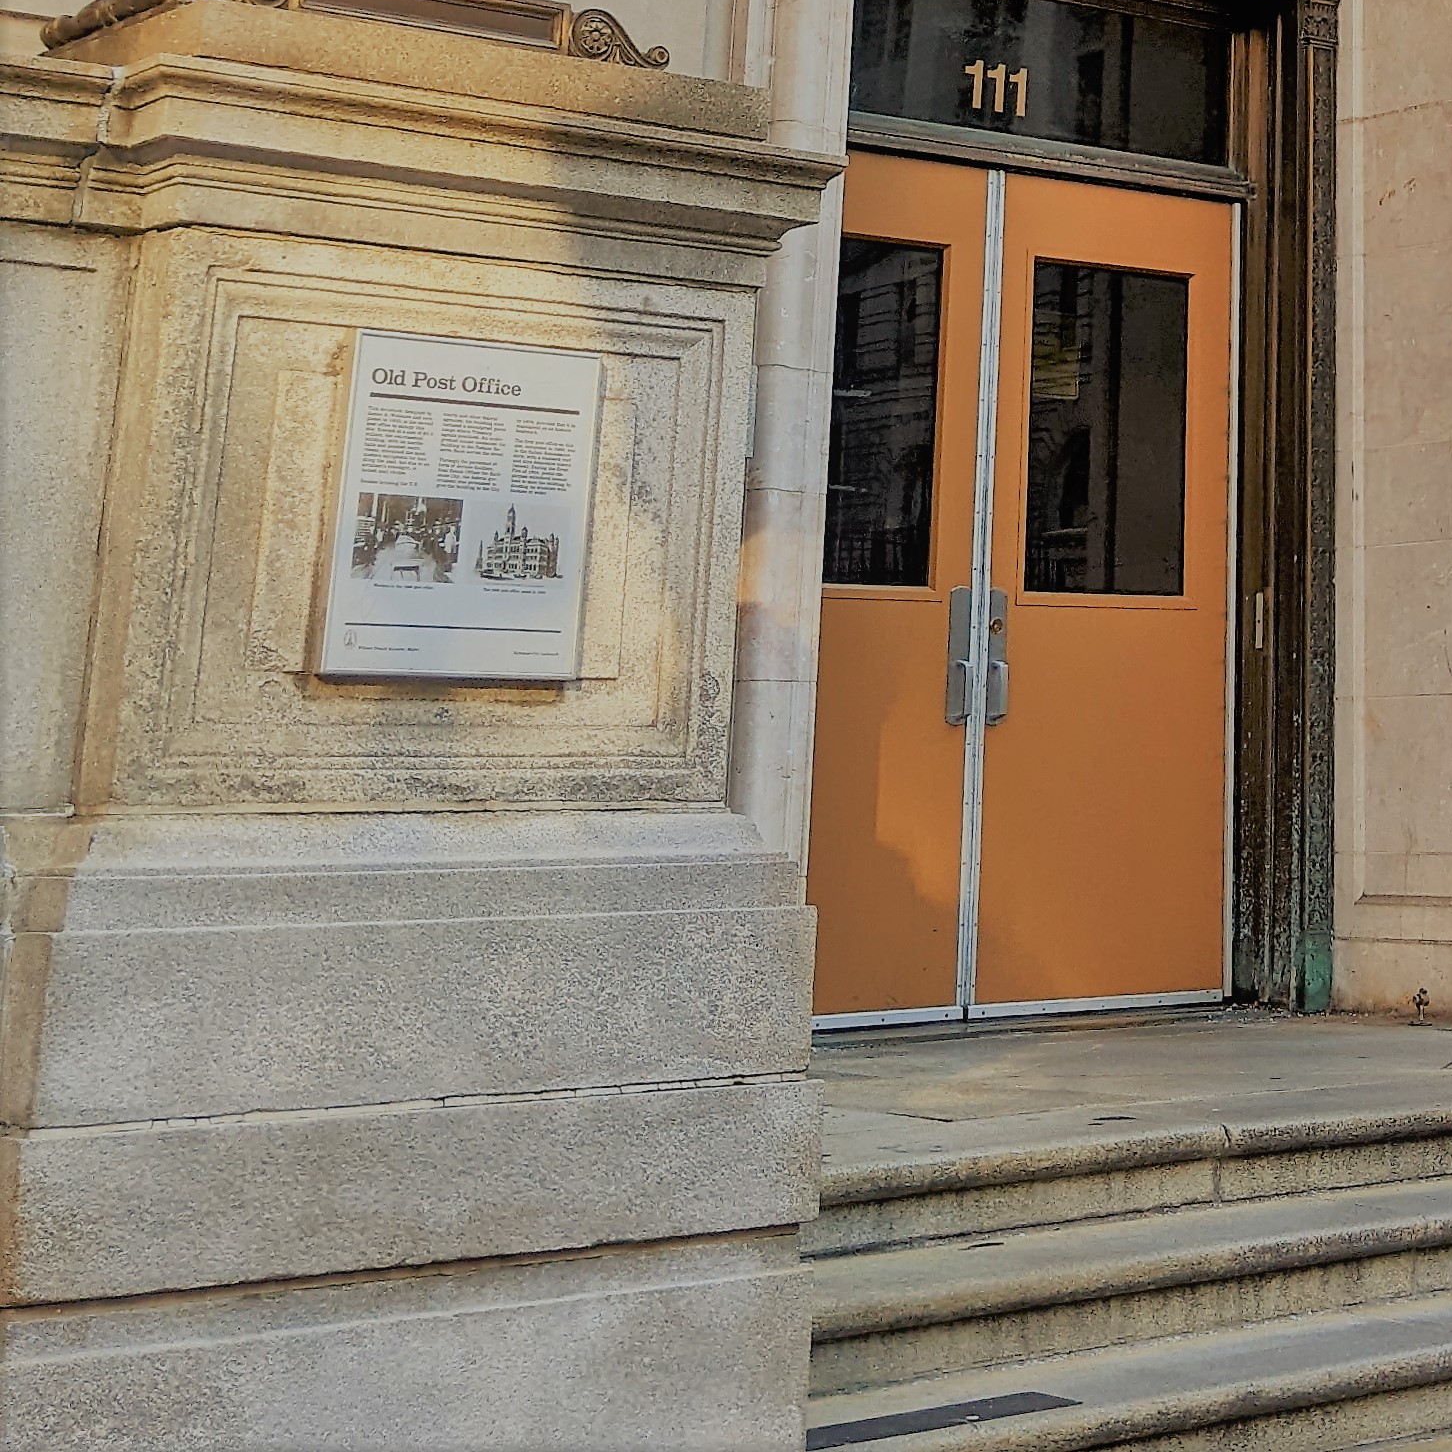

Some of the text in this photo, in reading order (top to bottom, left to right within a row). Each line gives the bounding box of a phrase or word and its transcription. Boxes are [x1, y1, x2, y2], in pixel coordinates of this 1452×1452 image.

[964, 59, 1029, 118] 111
[372, 367, 522, 397] Old Post Office
